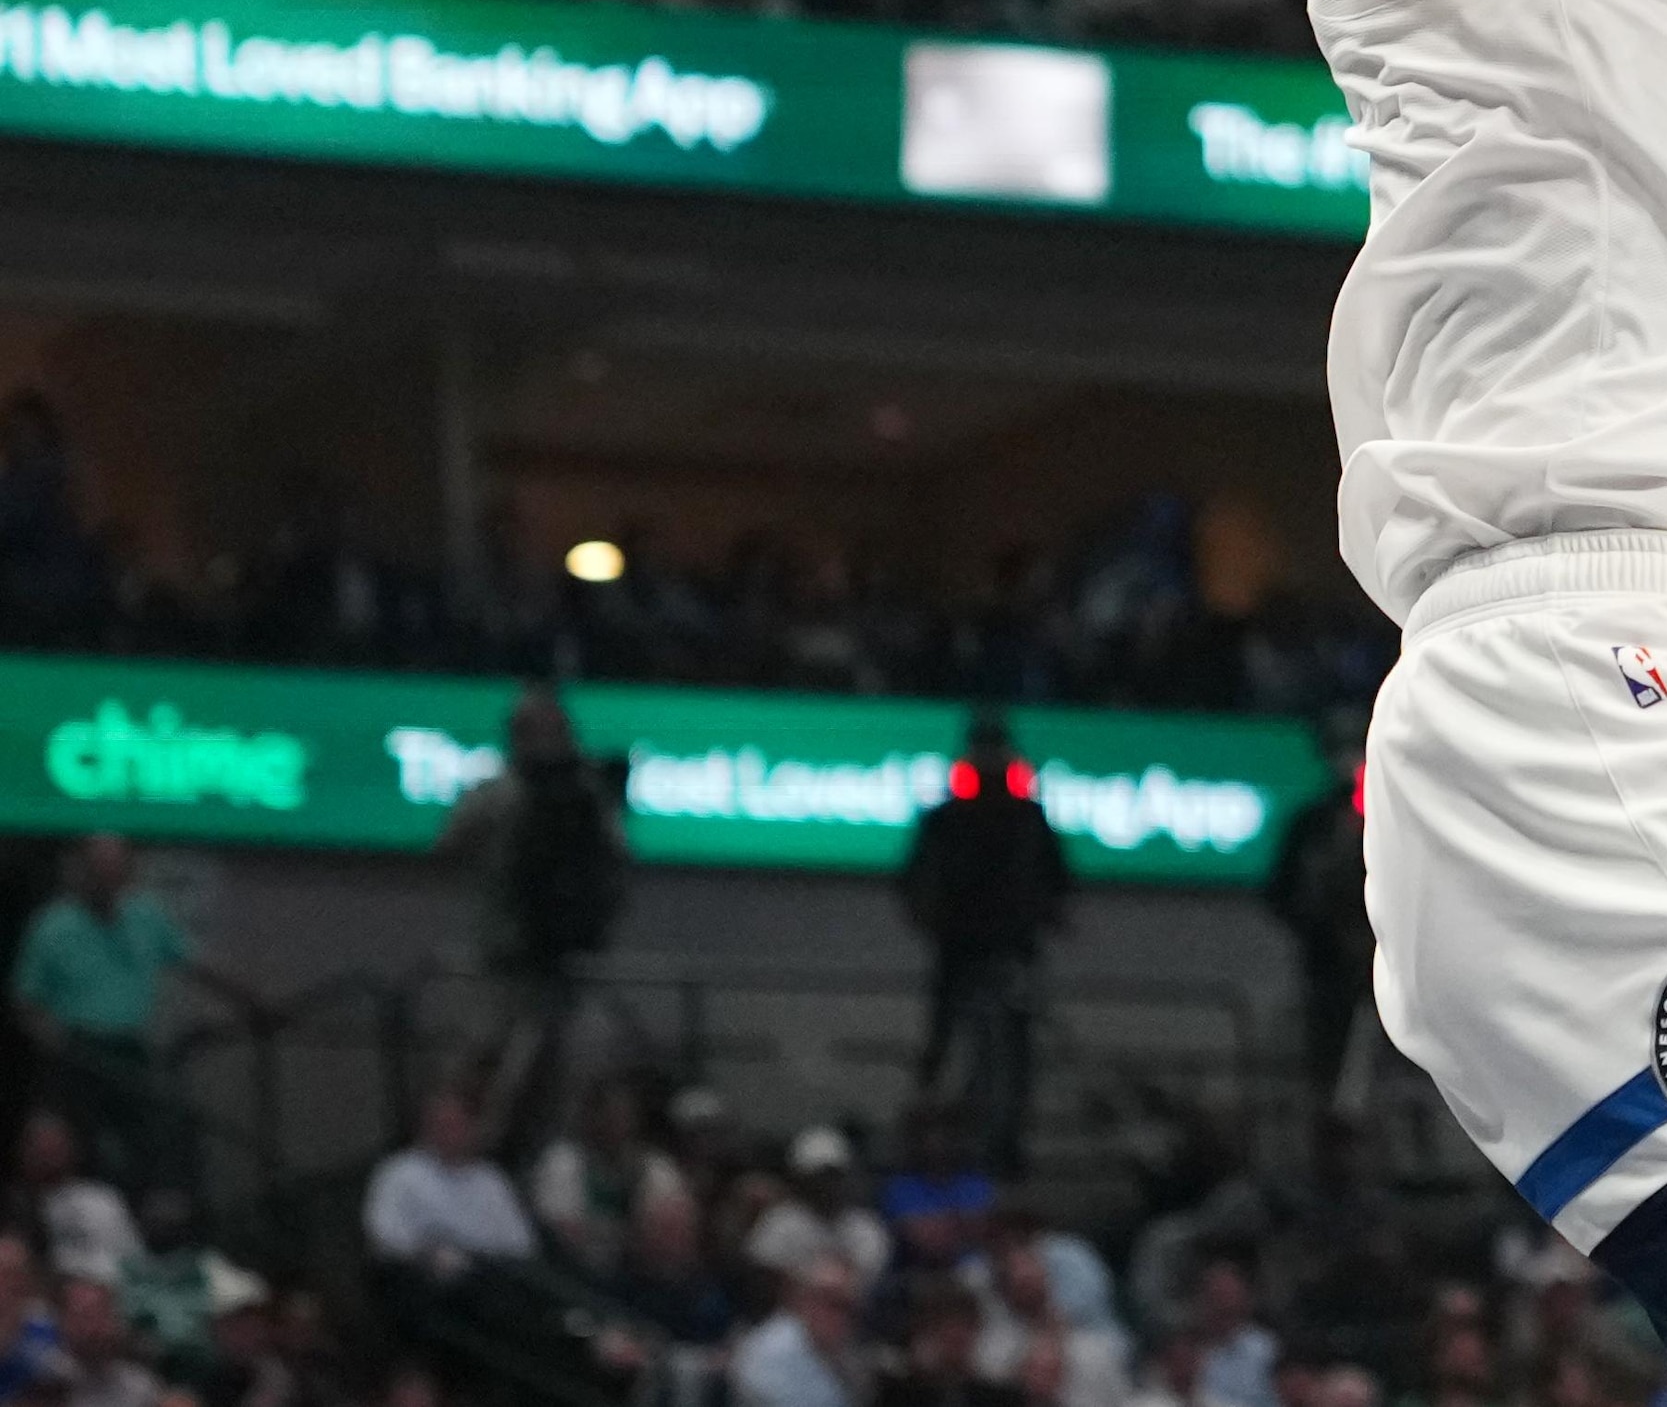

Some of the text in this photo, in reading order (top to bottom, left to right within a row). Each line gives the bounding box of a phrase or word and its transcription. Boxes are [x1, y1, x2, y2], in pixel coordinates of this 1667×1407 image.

[40, 10, 197, 90] Most
[201, 24, 386, 106] Loved
[389, 38, 628, 139] Banking
[630, 62, 767, 142] App
[46, 706, 306, 807] chime
